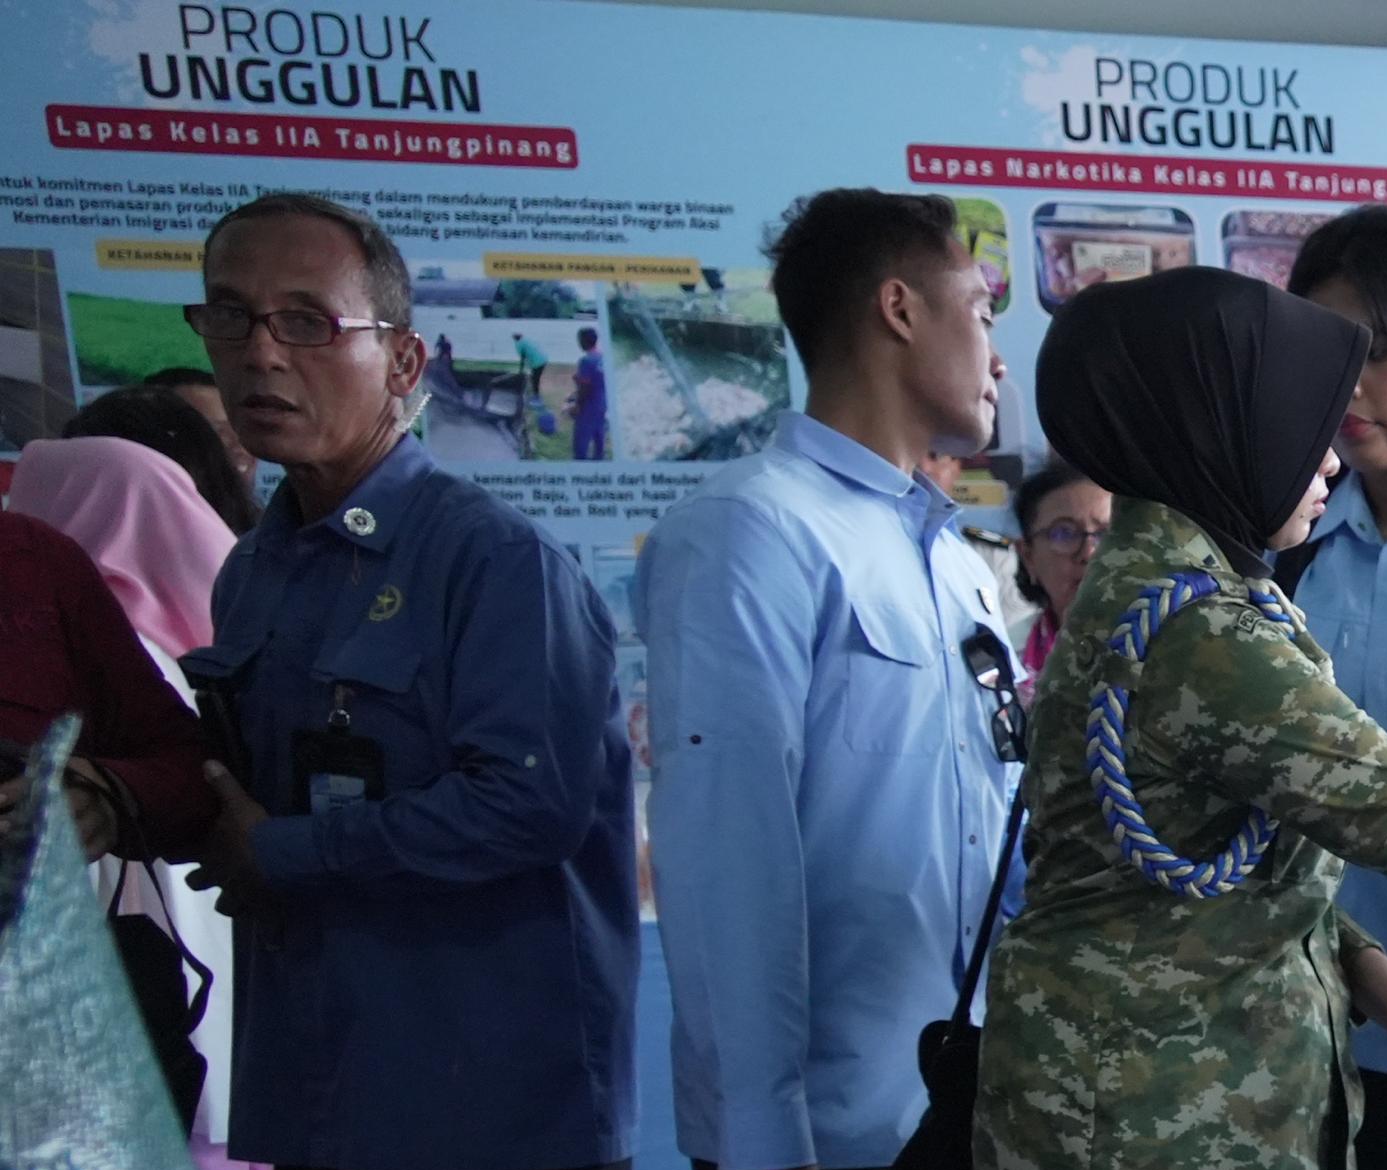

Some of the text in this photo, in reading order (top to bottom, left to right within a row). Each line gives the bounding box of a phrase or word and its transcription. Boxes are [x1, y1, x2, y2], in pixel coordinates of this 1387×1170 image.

[179, 4, 435, 63] PRODUK
[139, 53, 481, 112] UNGGULAN
[1095, 57, 1299, 109] PRODUK
[55, 115, 573, 163] Lapas Kelas IIA Tanjungpinang
[1061, 101, 1334, 154] UNGGULAN
[37, 176, 123, 193] komitmen
[127, 180, 175, 197] Lapas
[179, 182, 224, 197] Kelas
[374, 187, 423, 204] dalam
[426, 192, 517, 210] mendukung
[521, 195, 632, 213] pemberdayaan
[913, 153, 994, 179] Lapas
[1005, 157, 1142, 184] Narkotika
[1154, 163, 1226, 187] Kelas
[1237, 168, 1275, 190] IIA
[13, 210, 122, 228] Kementerian
[444, 226, 527, 241] pembinaan
[44, 195, 74, 209] dan
[79, 196, 172, 212] pemasaran
[177, 199, 232, 215] produk
[377, 206, 449, 224] sekaligus
[454, 209, 511, 226] sebagai
